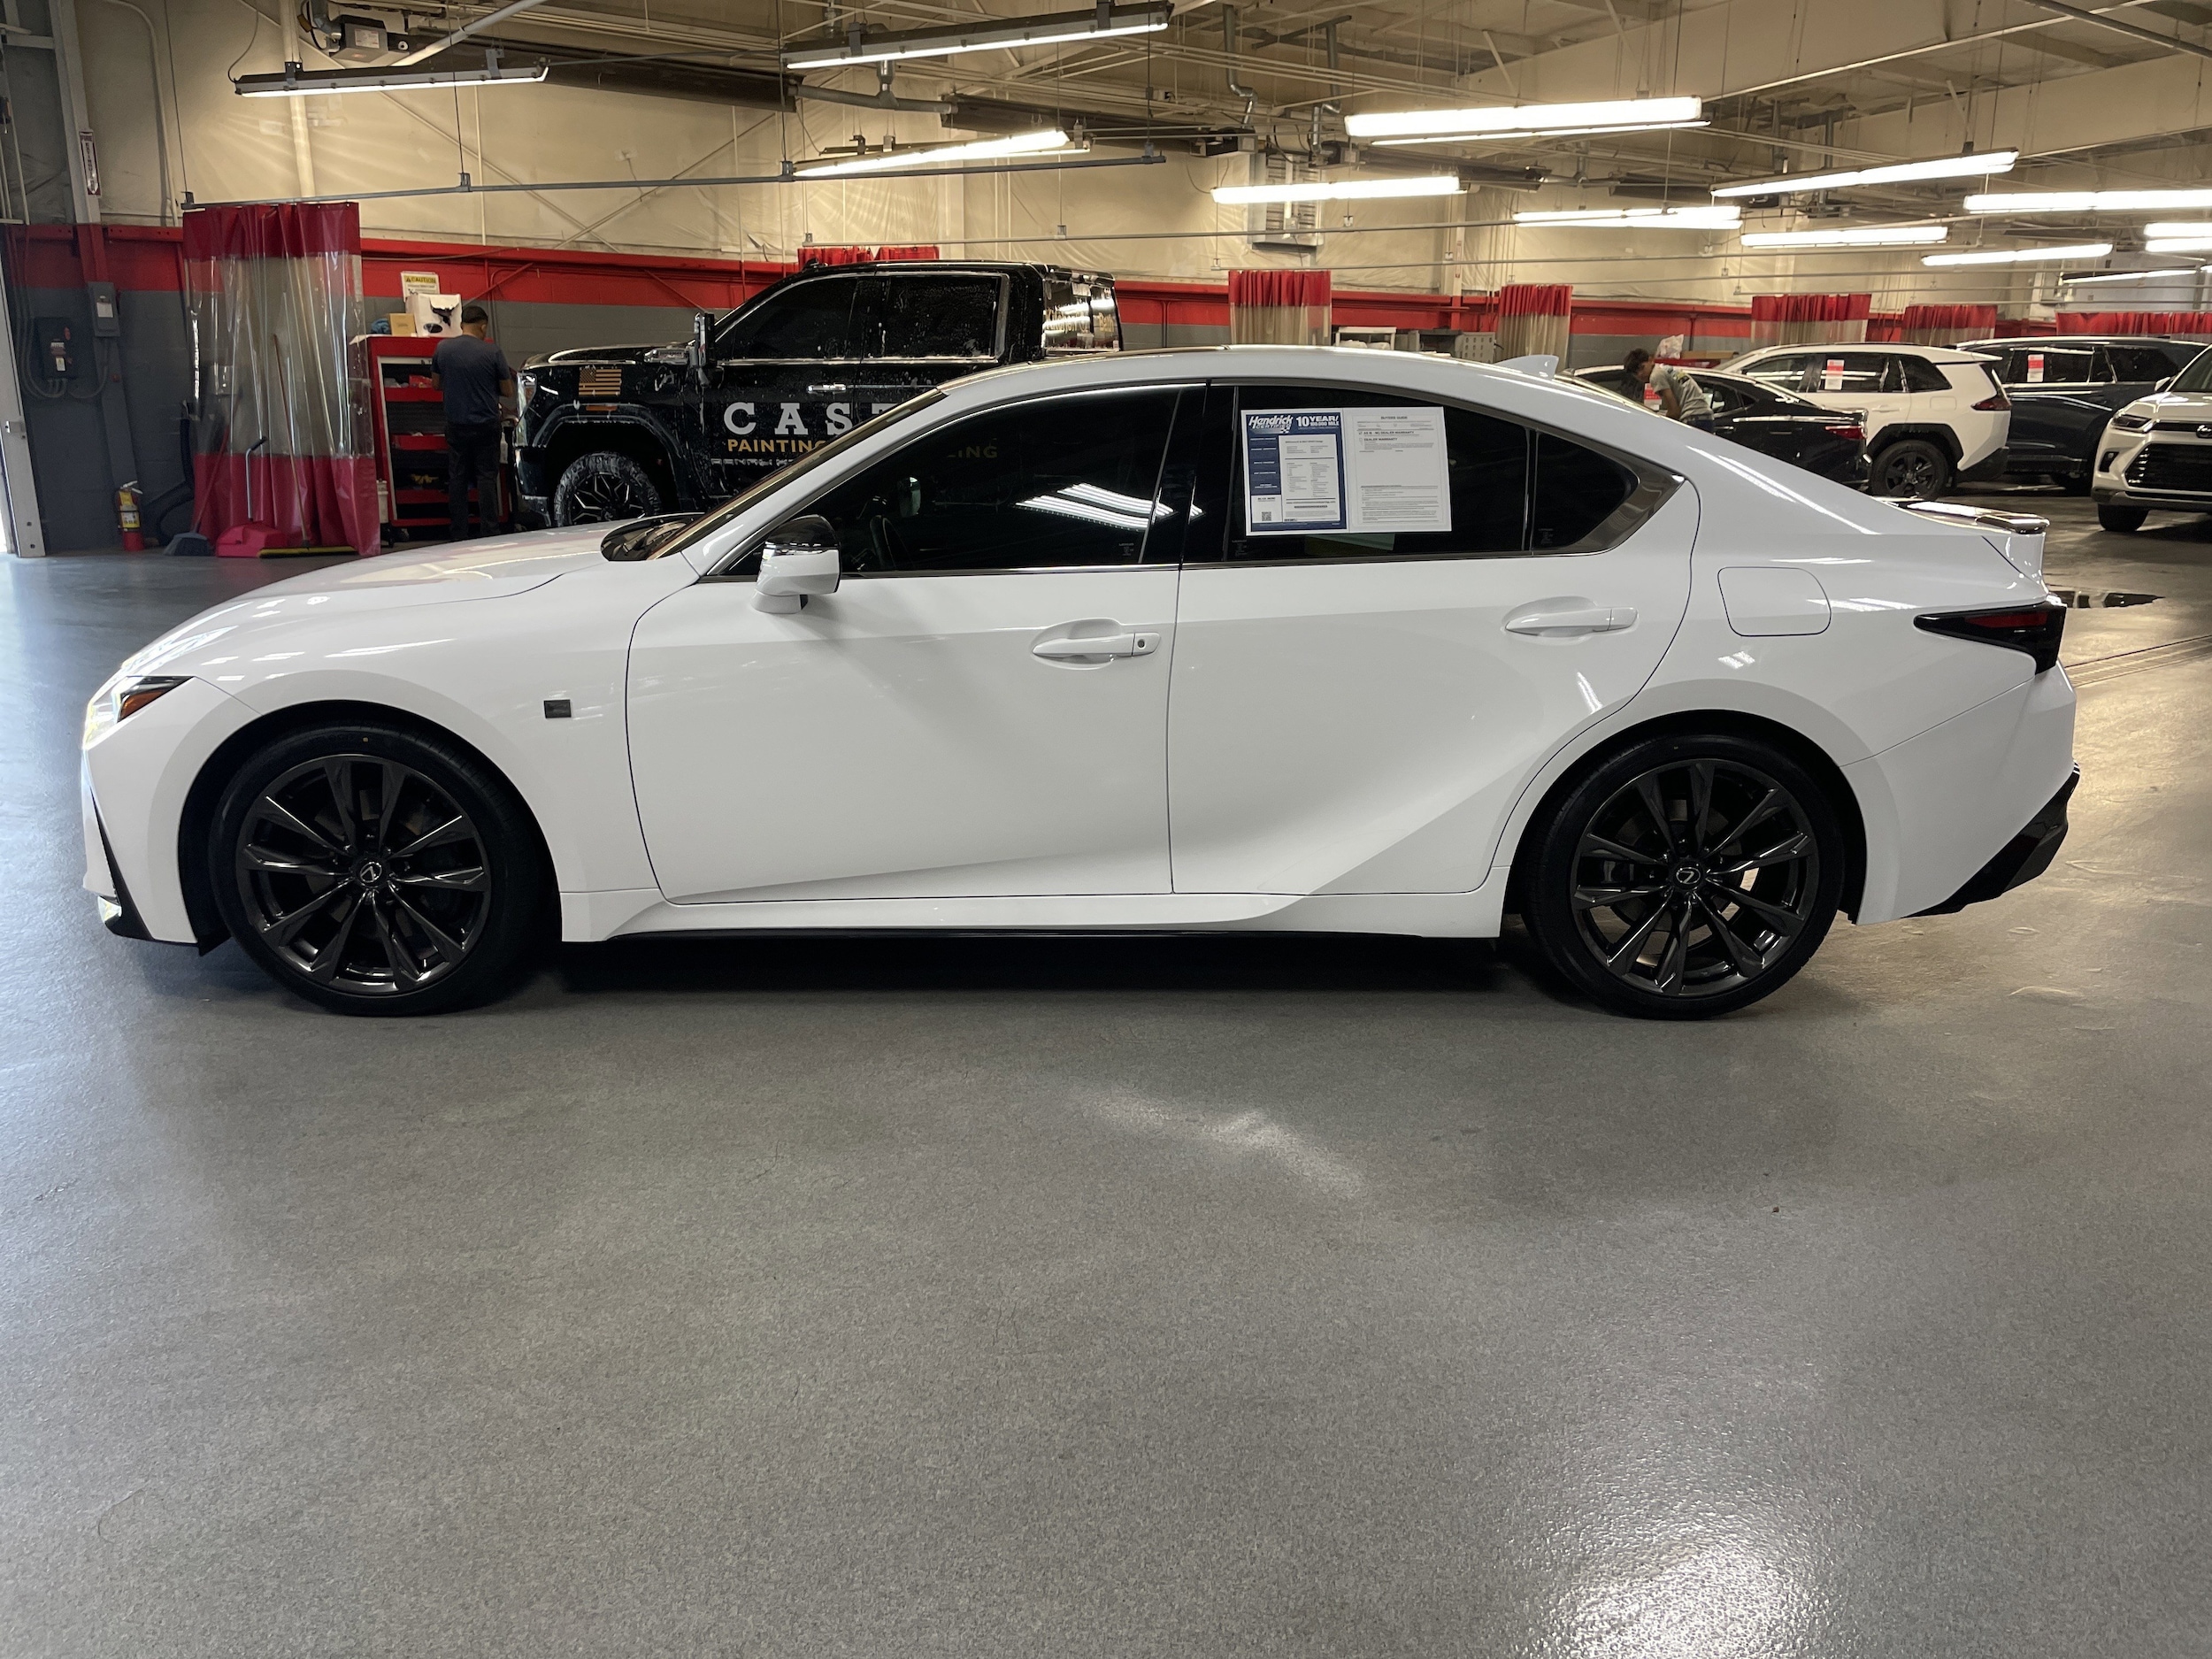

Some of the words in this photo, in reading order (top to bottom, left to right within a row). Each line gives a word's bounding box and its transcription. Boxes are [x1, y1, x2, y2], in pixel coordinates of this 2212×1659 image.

[1248, 415, 1294, 429] Hendrick
[1296, 416, 1310, 426] 10
[948, 445, 999, 458] ING
